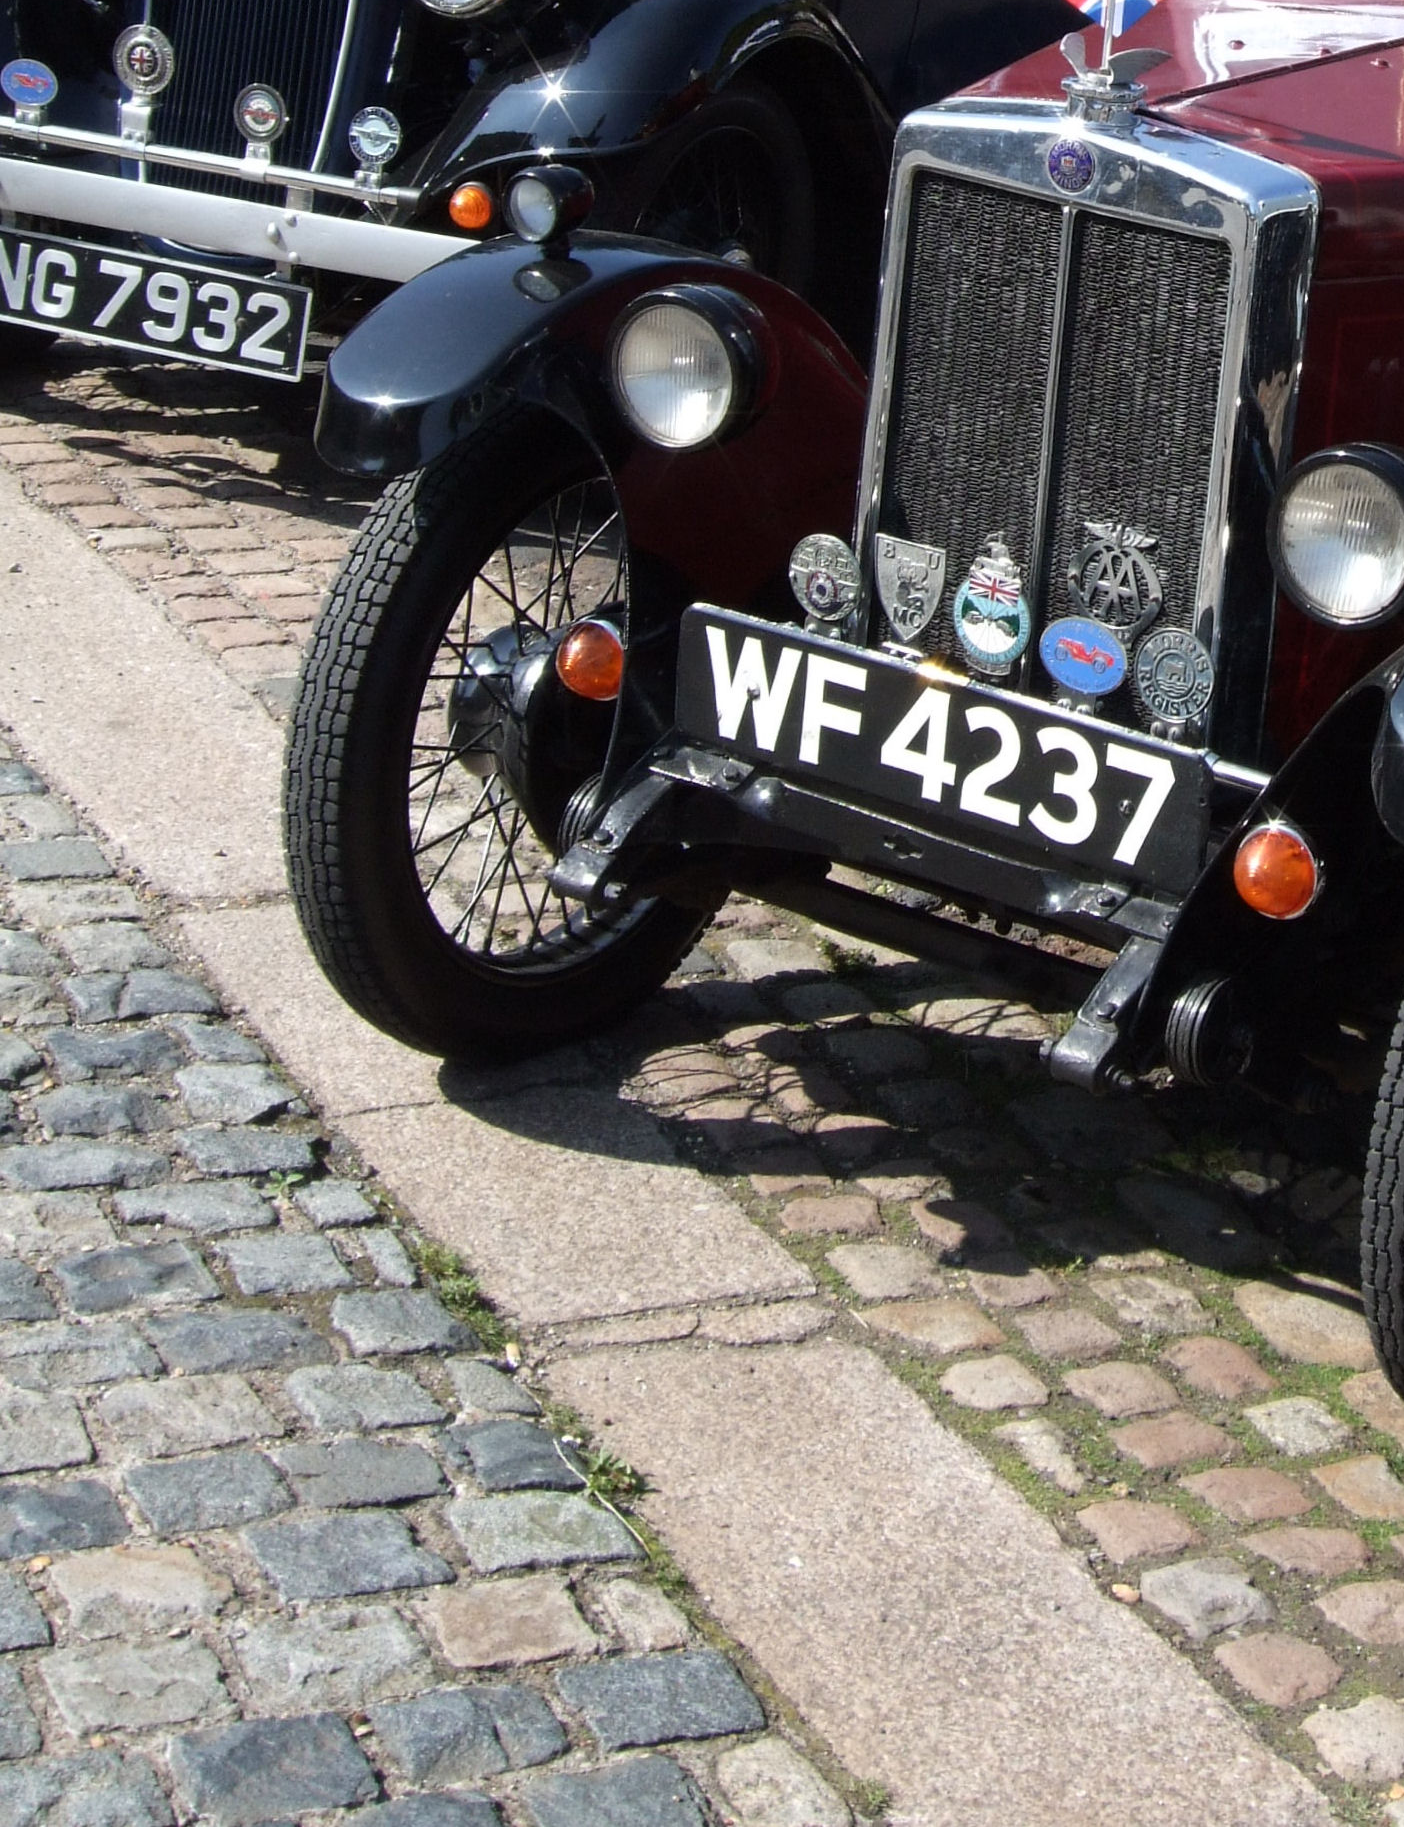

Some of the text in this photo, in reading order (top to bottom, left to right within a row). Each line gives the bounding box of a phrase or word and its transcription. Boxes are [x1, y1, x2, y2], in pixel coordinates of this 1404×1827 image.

[93, 259, 291, 365] 7932
[926, 552, 940, 569] U
[893, 606, 923, 630] MC
[1139, 667, 1212, 716] REGISTER
[706, 626, 867, 765] WF
[880, 688, 1175, 865] 4237
